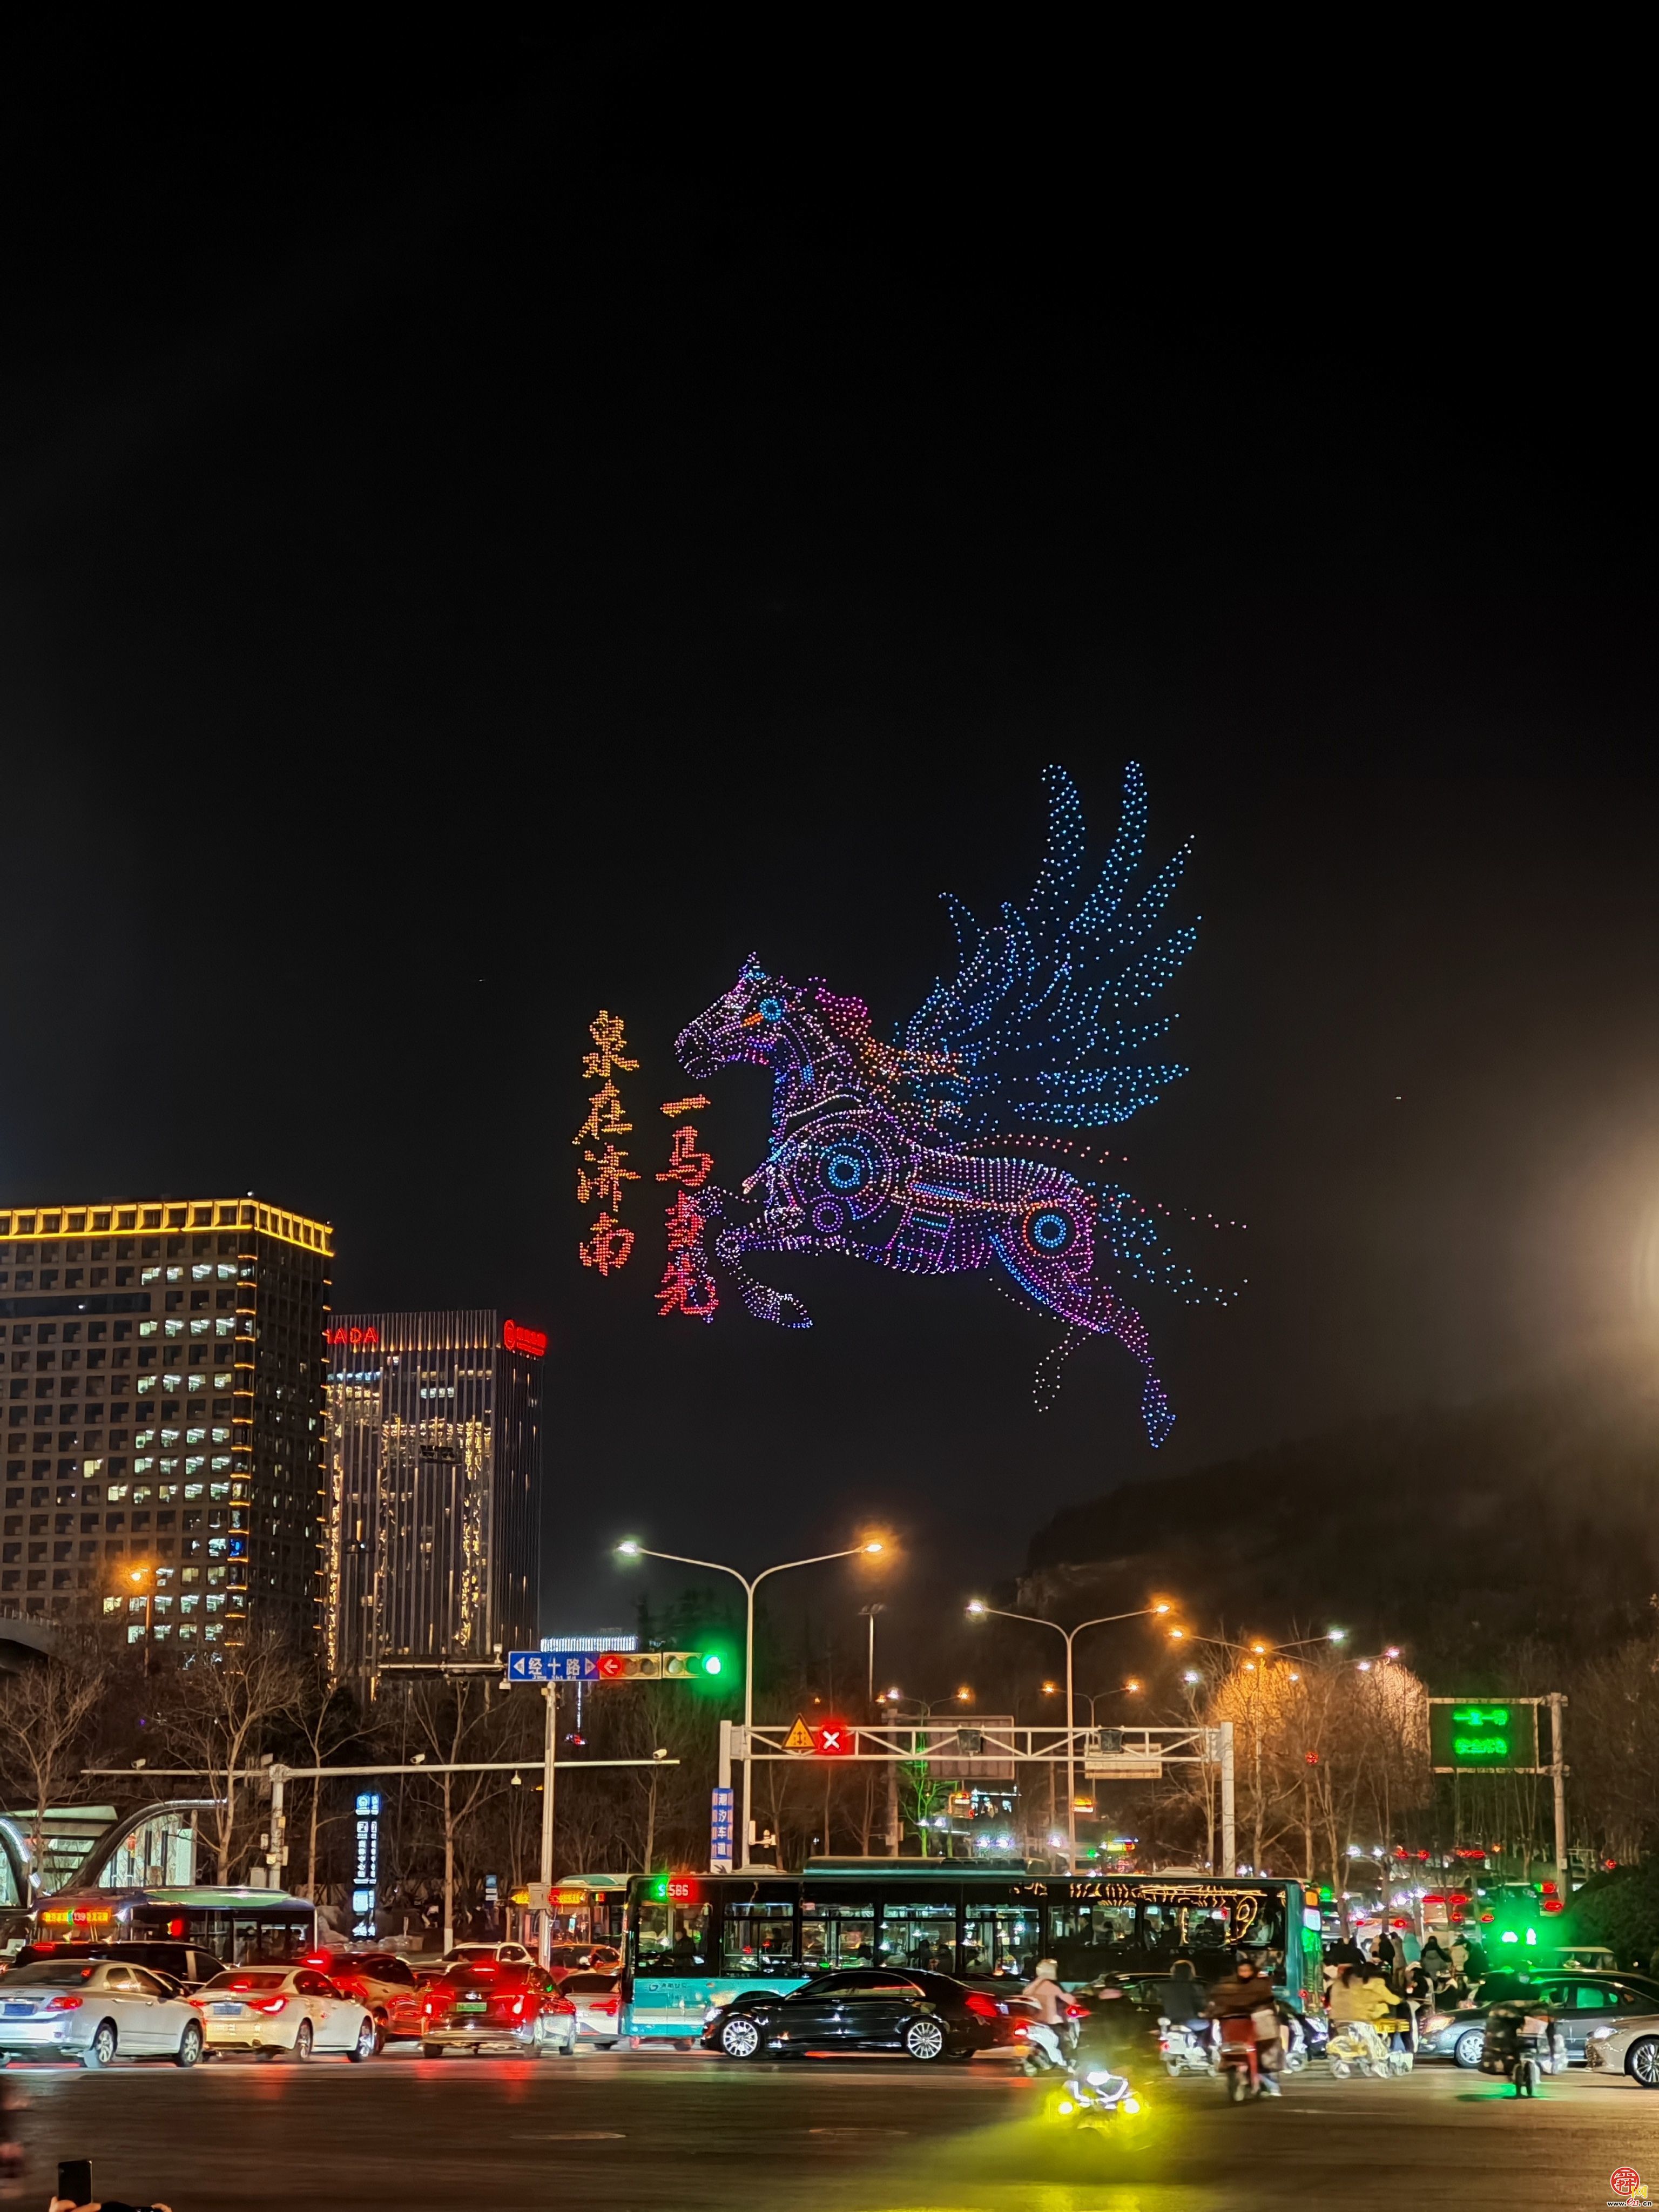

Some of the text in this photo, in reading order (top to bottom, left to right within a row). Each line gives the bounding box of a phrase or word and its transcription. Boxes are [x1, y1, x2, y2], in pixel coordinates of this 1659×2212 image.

[326, 1326, 378, 1345] ADA
[528, 1657, 581, 1675] 经十路
